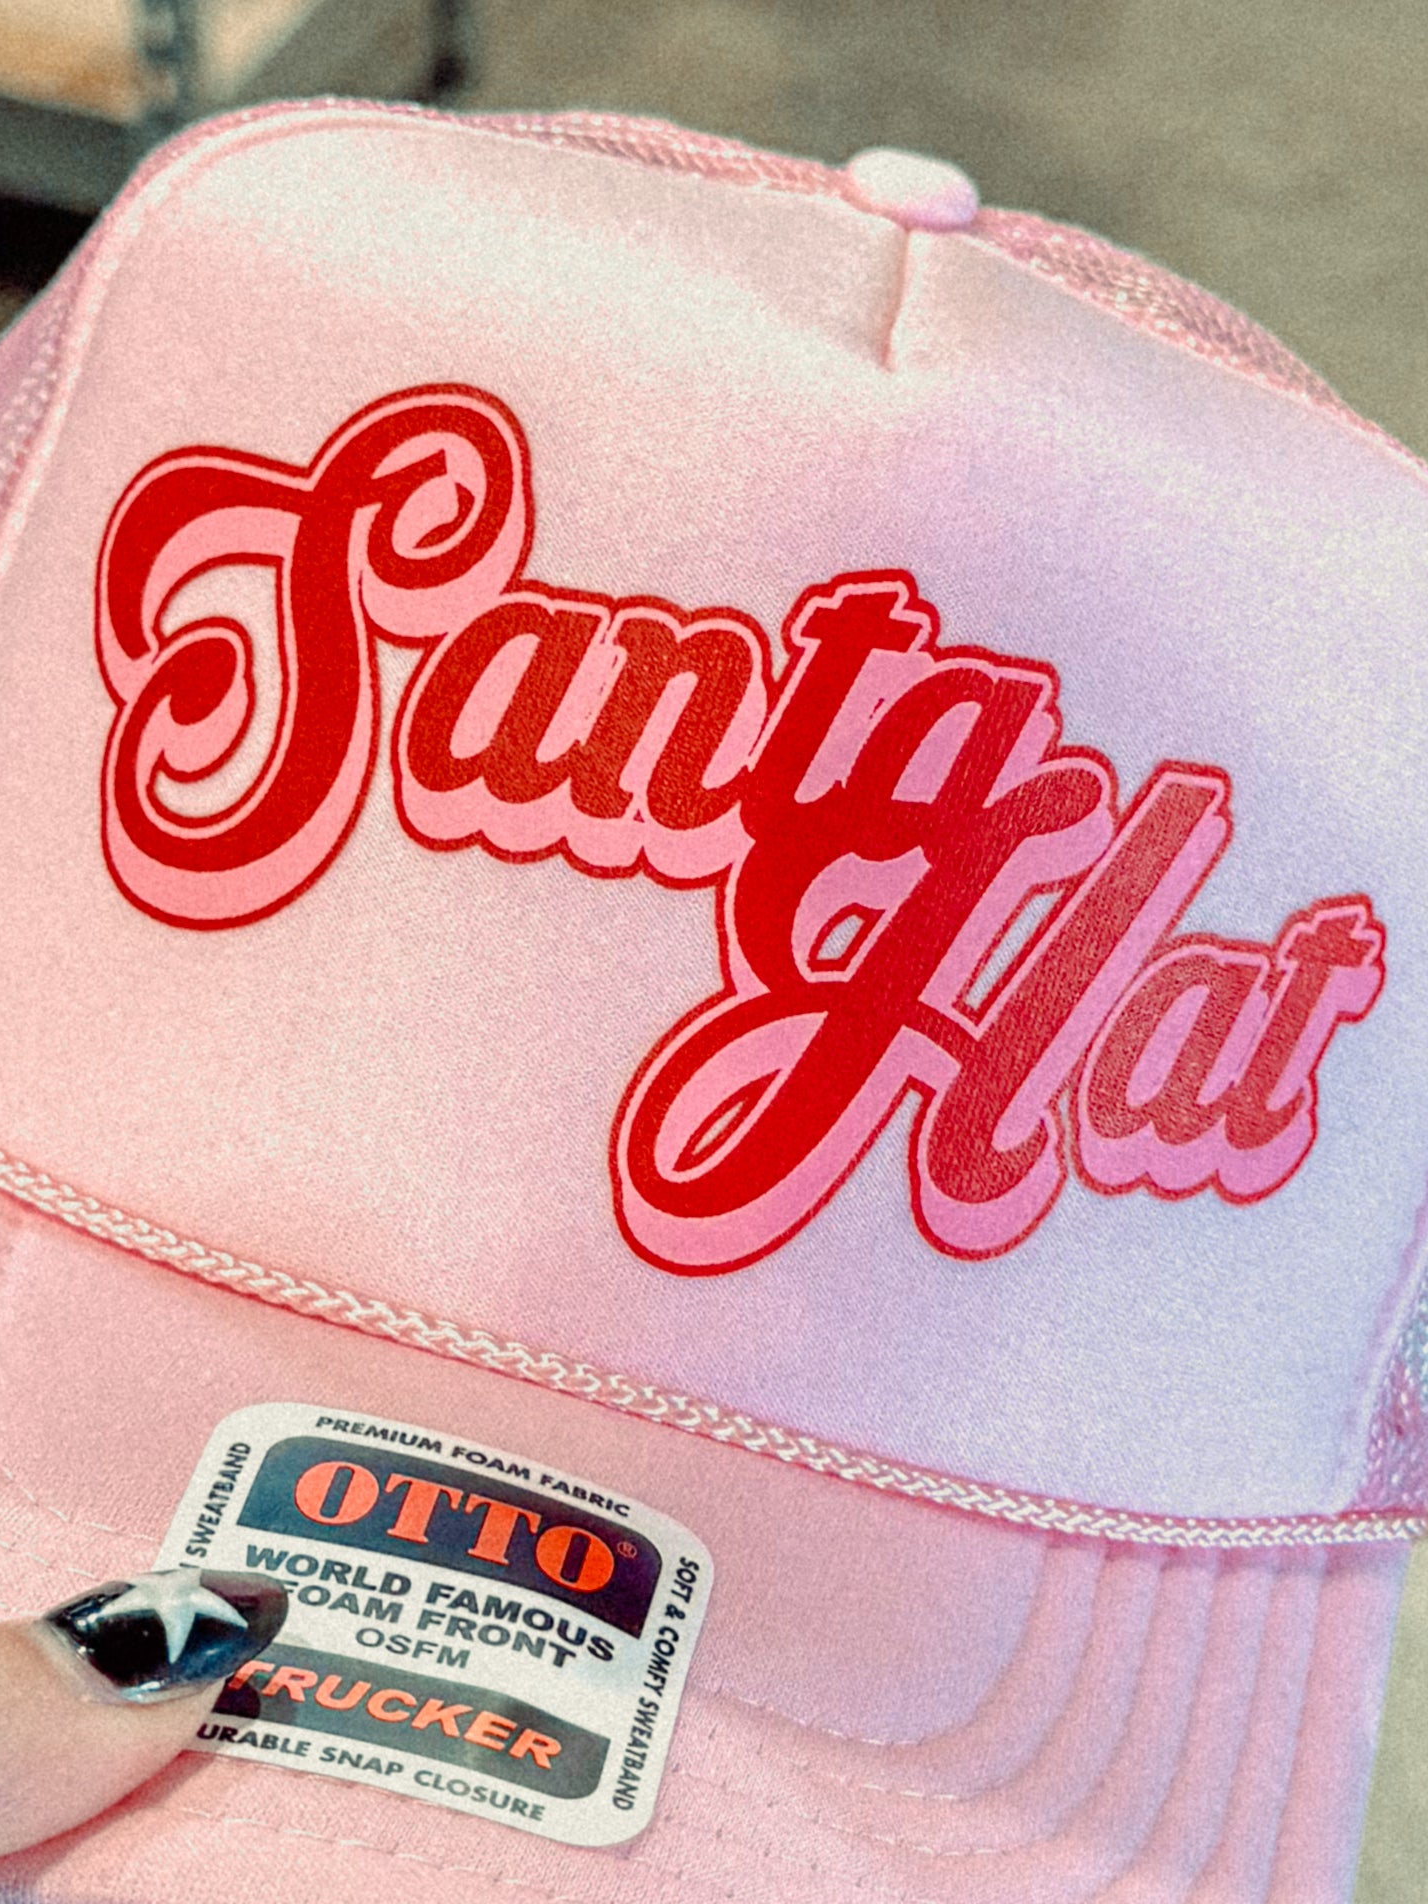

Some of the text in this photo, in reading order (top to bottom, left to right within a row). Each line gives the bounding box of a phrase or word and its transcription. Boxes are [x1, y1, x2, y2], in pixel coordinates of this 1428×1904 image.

[95, 382, 1062, 930] Santa
[610, 746, 1388, 1278] Hat
[184, 1441, 252, 1559] SWEATBAND
[315, 1415, 632, 1518] PREMIUM FOAM FABRIC
[244, 1543, 616, 1663] WORLD FAMOUS
[355, 1626, 472, 1670] OSFM
[416, 1608, 578, 1669] FRONT
[226, 1659, 563, 1770] TRUCKER
[611, 1556, 700, 1812] SOFT & COMFY SWEATBAND
[195, 1721, 546, 1822] URABLE SNAP CLOSURE
